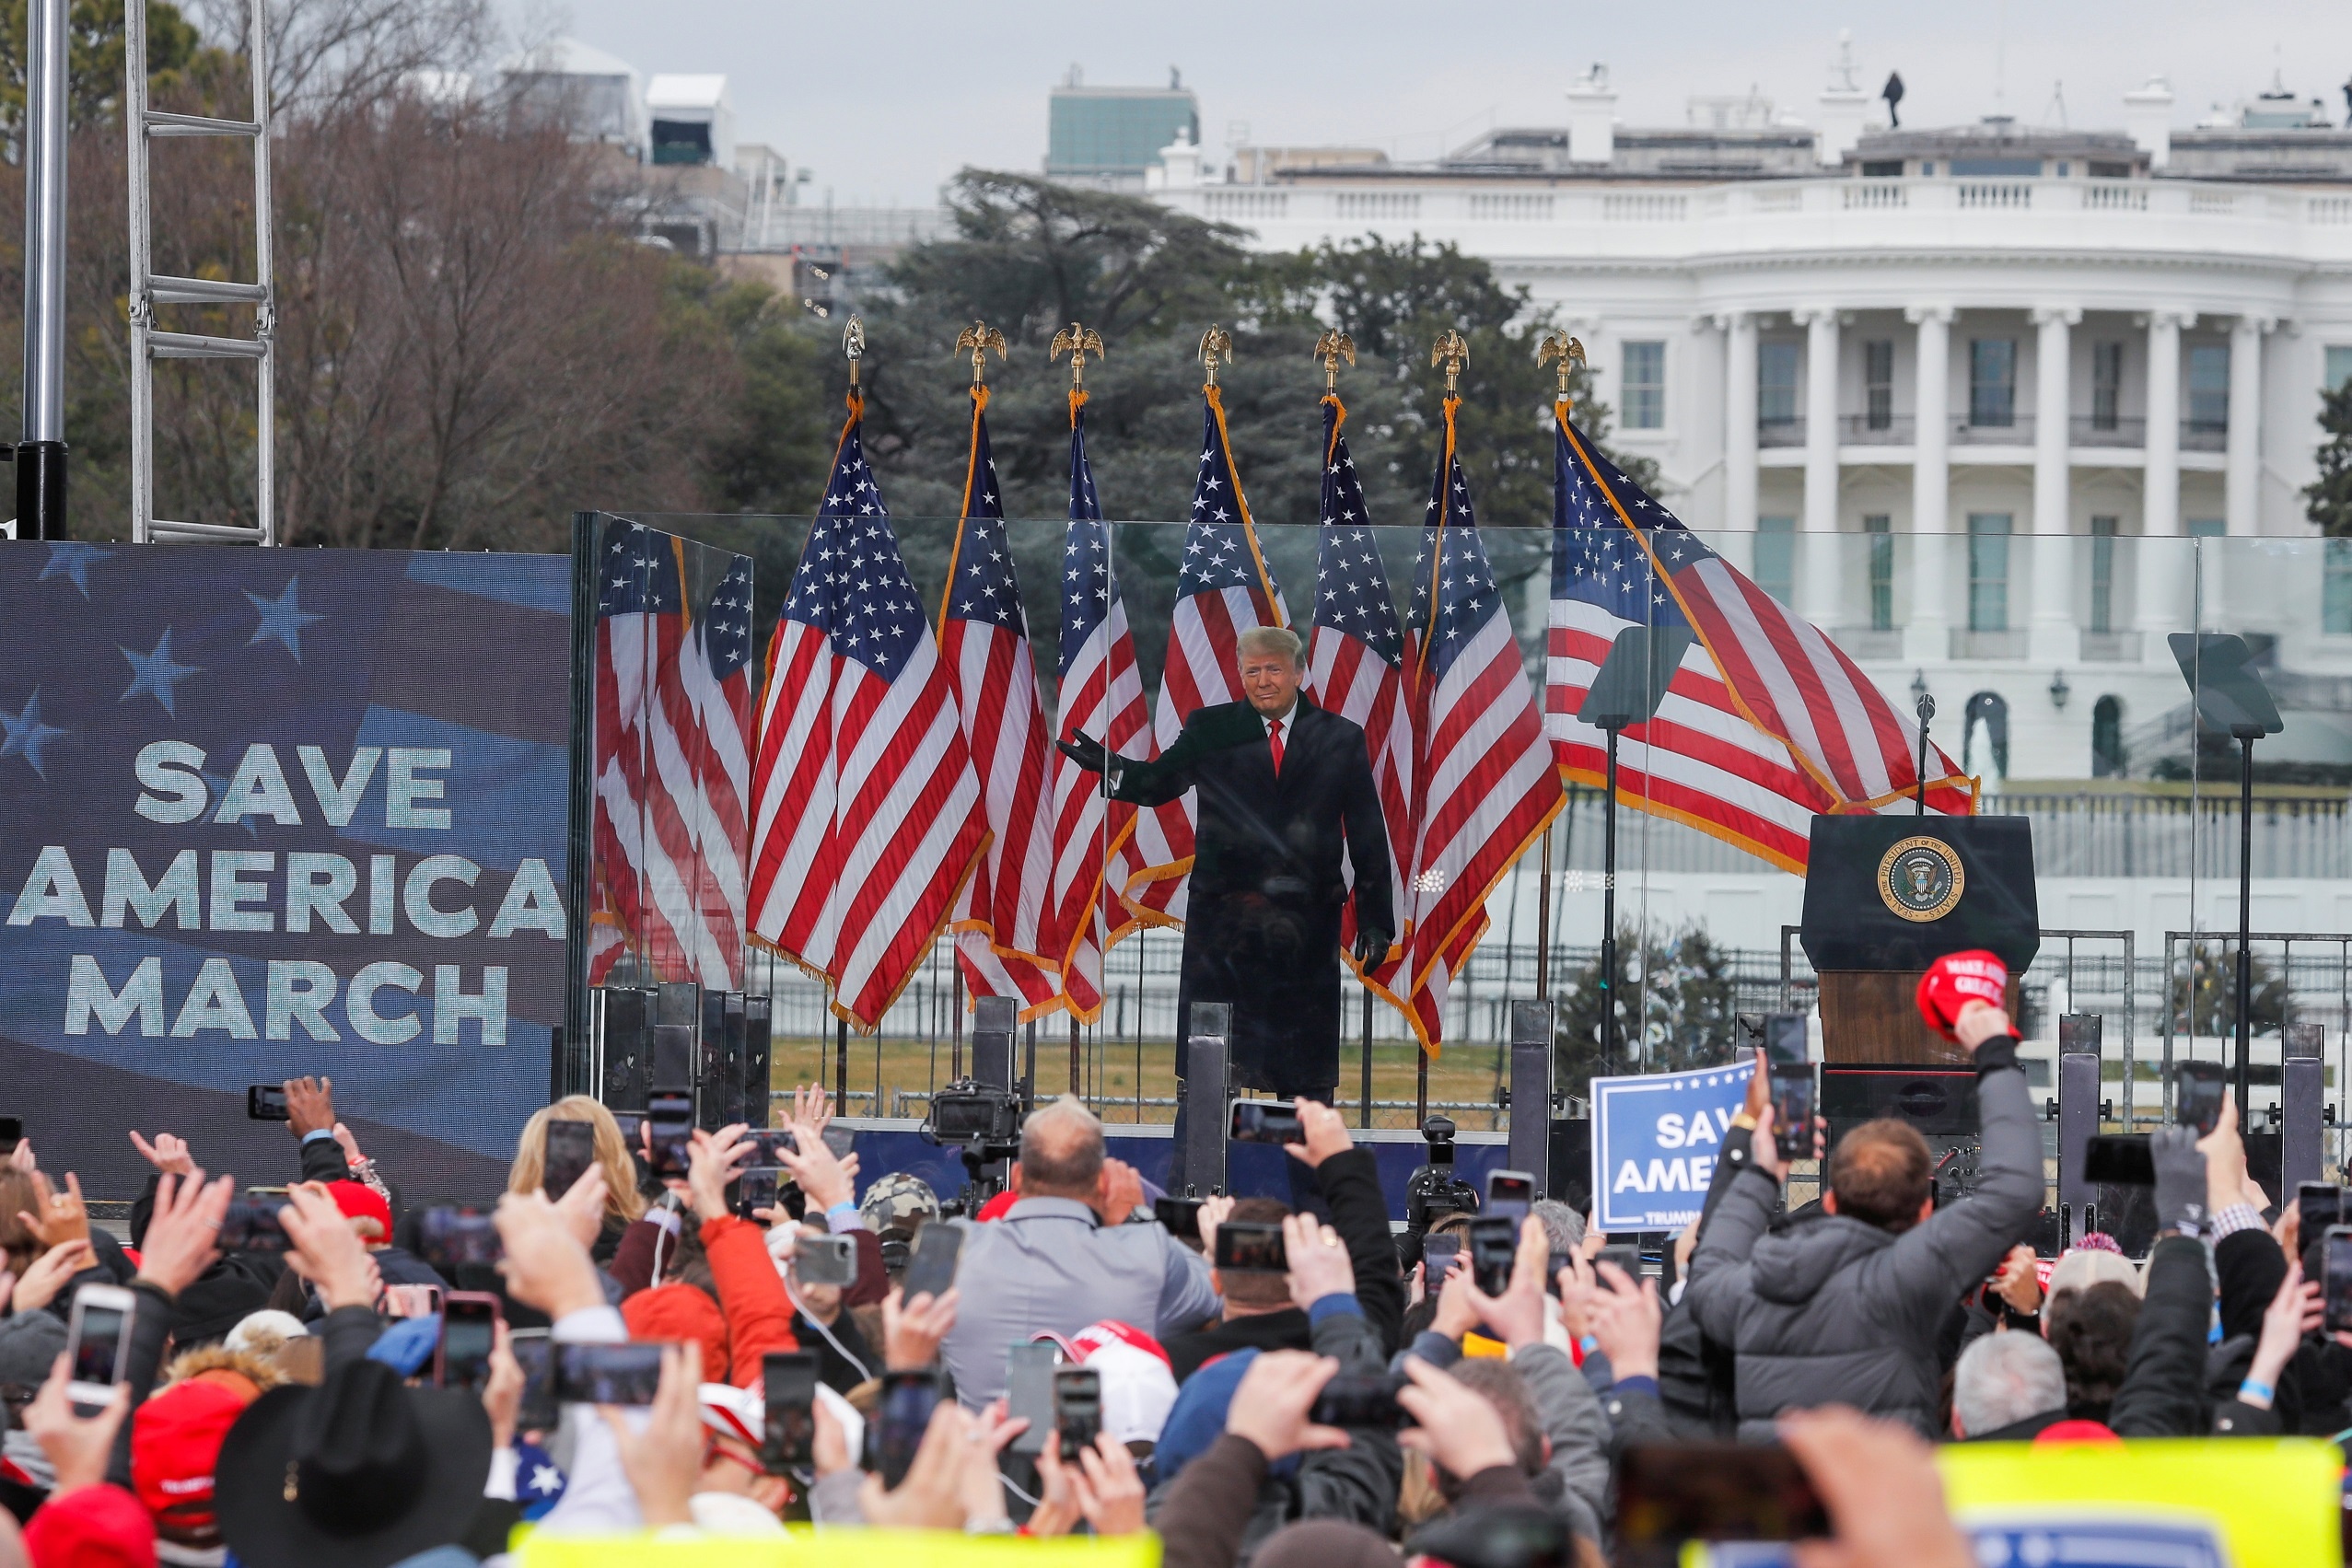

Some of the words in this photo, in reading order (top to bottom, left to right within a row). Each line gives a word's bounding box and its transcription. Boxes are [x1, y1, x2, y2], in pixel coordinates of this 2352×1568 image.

[134, 740, 452, 829] SAVE
[1881, 839, 1918, 877] PRESIDENT
[1931, 842, 1942, 850] THE
[1943, 850, 1962, 885] UNITED
[6, 845, 567, 939] AMERICA
[1892, 900, 1914, 917] SEAL
[1929, 892, 1959, 918] STATES
[64, 955, 508, 1045] MARCH
[1656, 1103, 1743, 1149] SAV
[1613, 1155, 1718, 1193] AME
